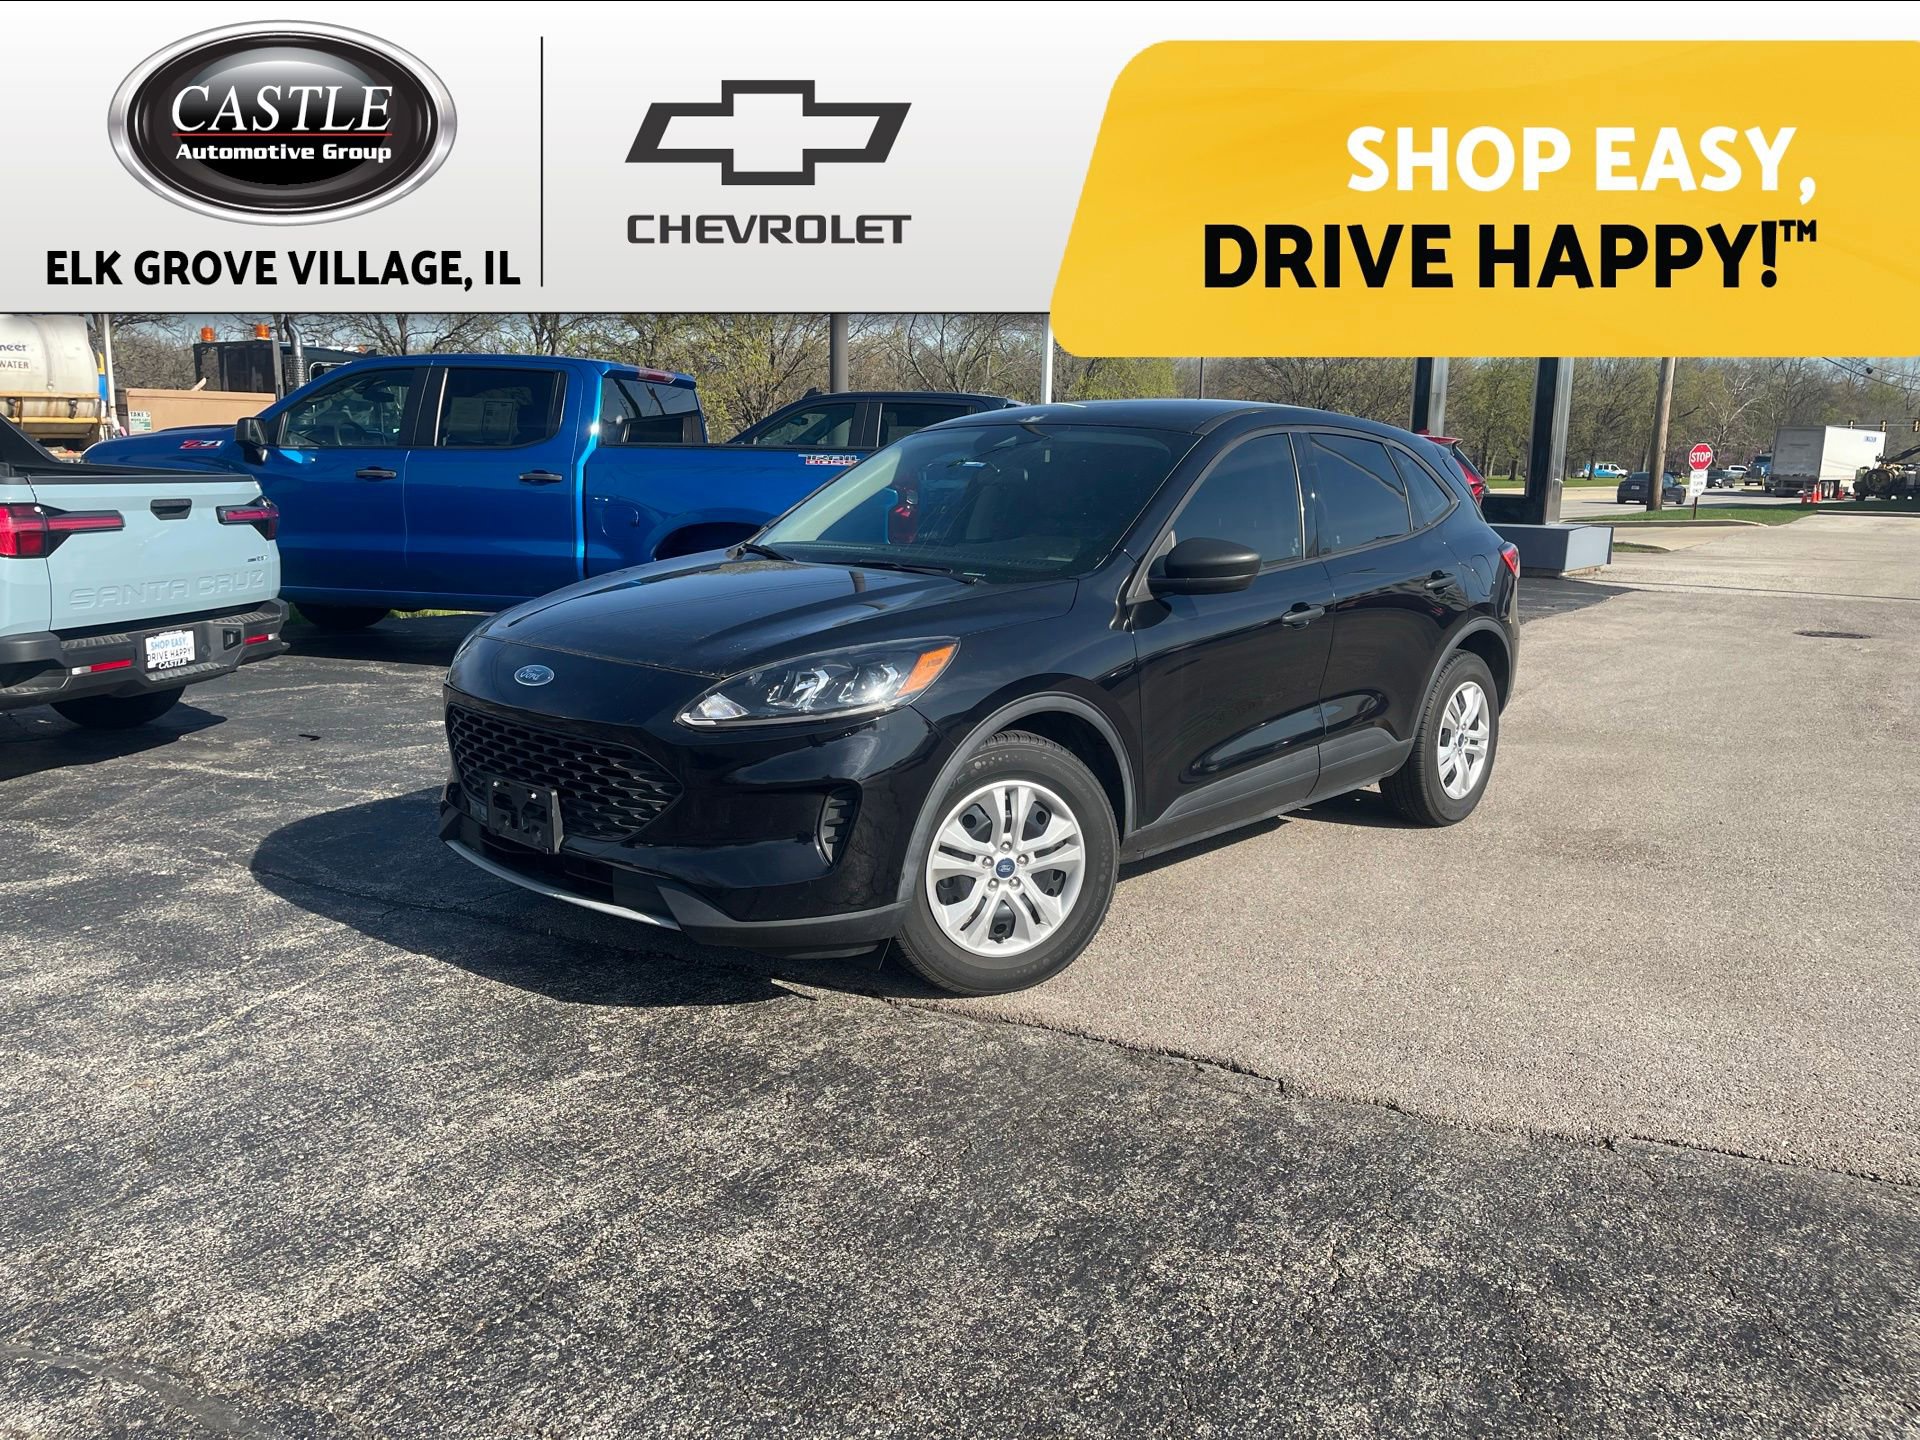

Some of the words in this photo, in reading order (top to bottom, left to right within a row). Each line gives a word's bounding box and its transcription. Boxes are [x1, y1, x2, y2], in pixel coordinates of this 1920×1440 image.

[180, 440, 224, 449] Z71
[1691, 452, 1711, 463] STOP
[69, 578, 190, 610] SANTA
[198, 569, 265, 595] CRUZ
[150, 640, 170, 651] SHOP
[159, 657, 187, 670] CASTLE
[519, 668, 546, 681] Ford
